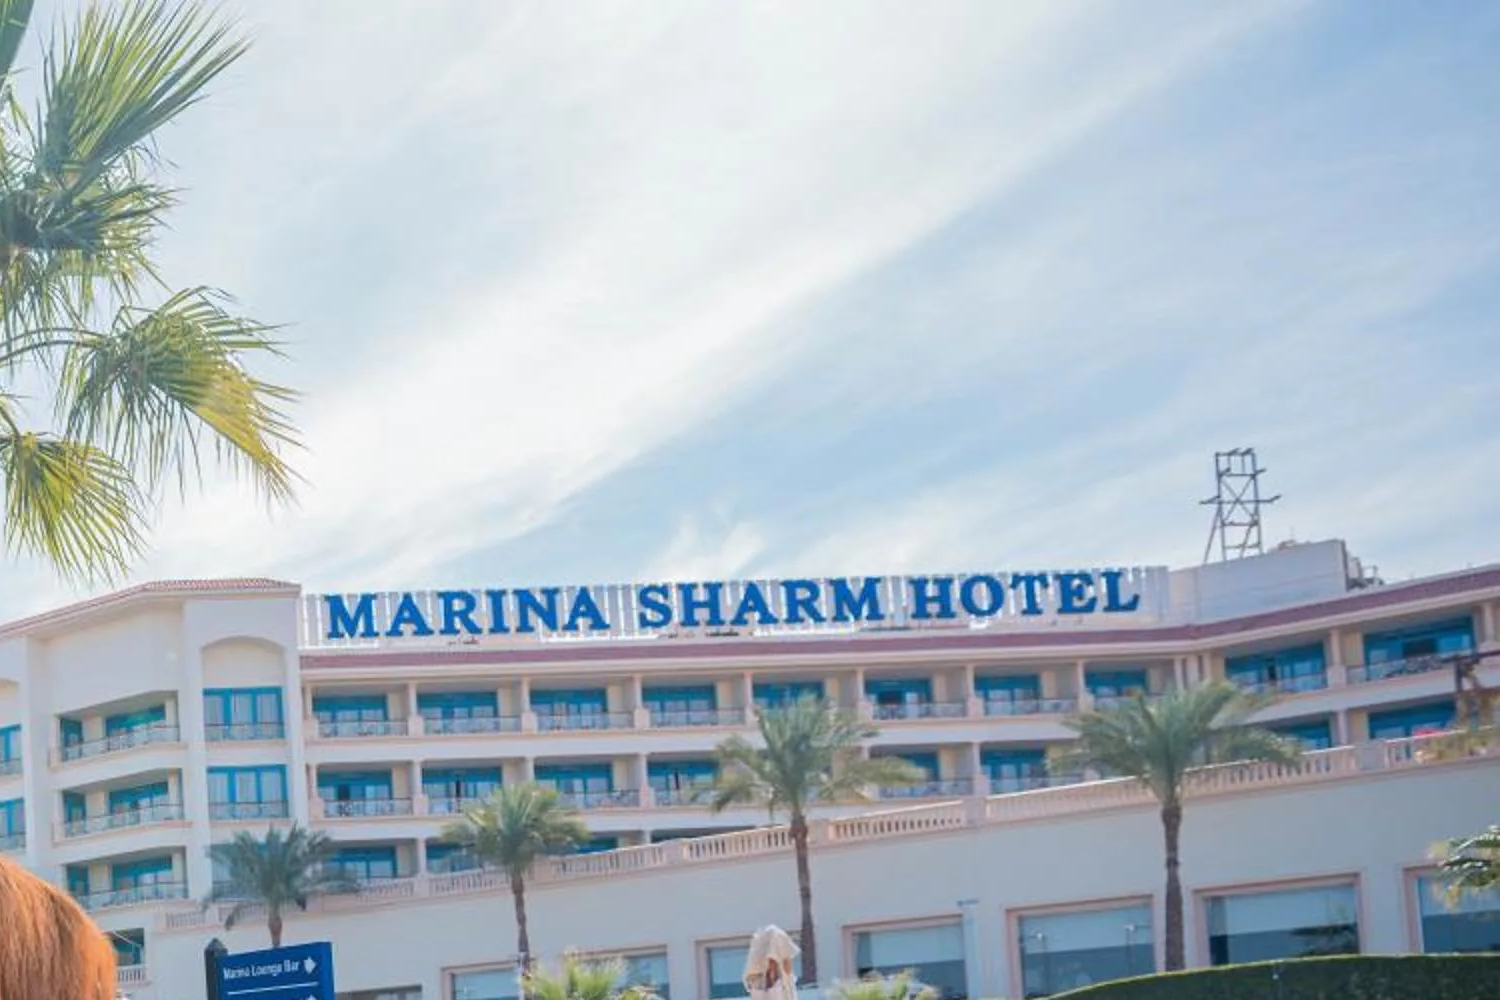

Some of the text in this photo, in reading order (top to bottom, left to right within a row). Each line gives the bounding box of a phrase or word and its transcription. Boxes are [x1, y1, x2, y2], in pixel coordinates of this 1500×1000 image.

[324, 570, 1141, 640] MARINA SHARM HOTEL
[223, 966, 251, 980] Marina
[283, 959, 300, 973] Bar
